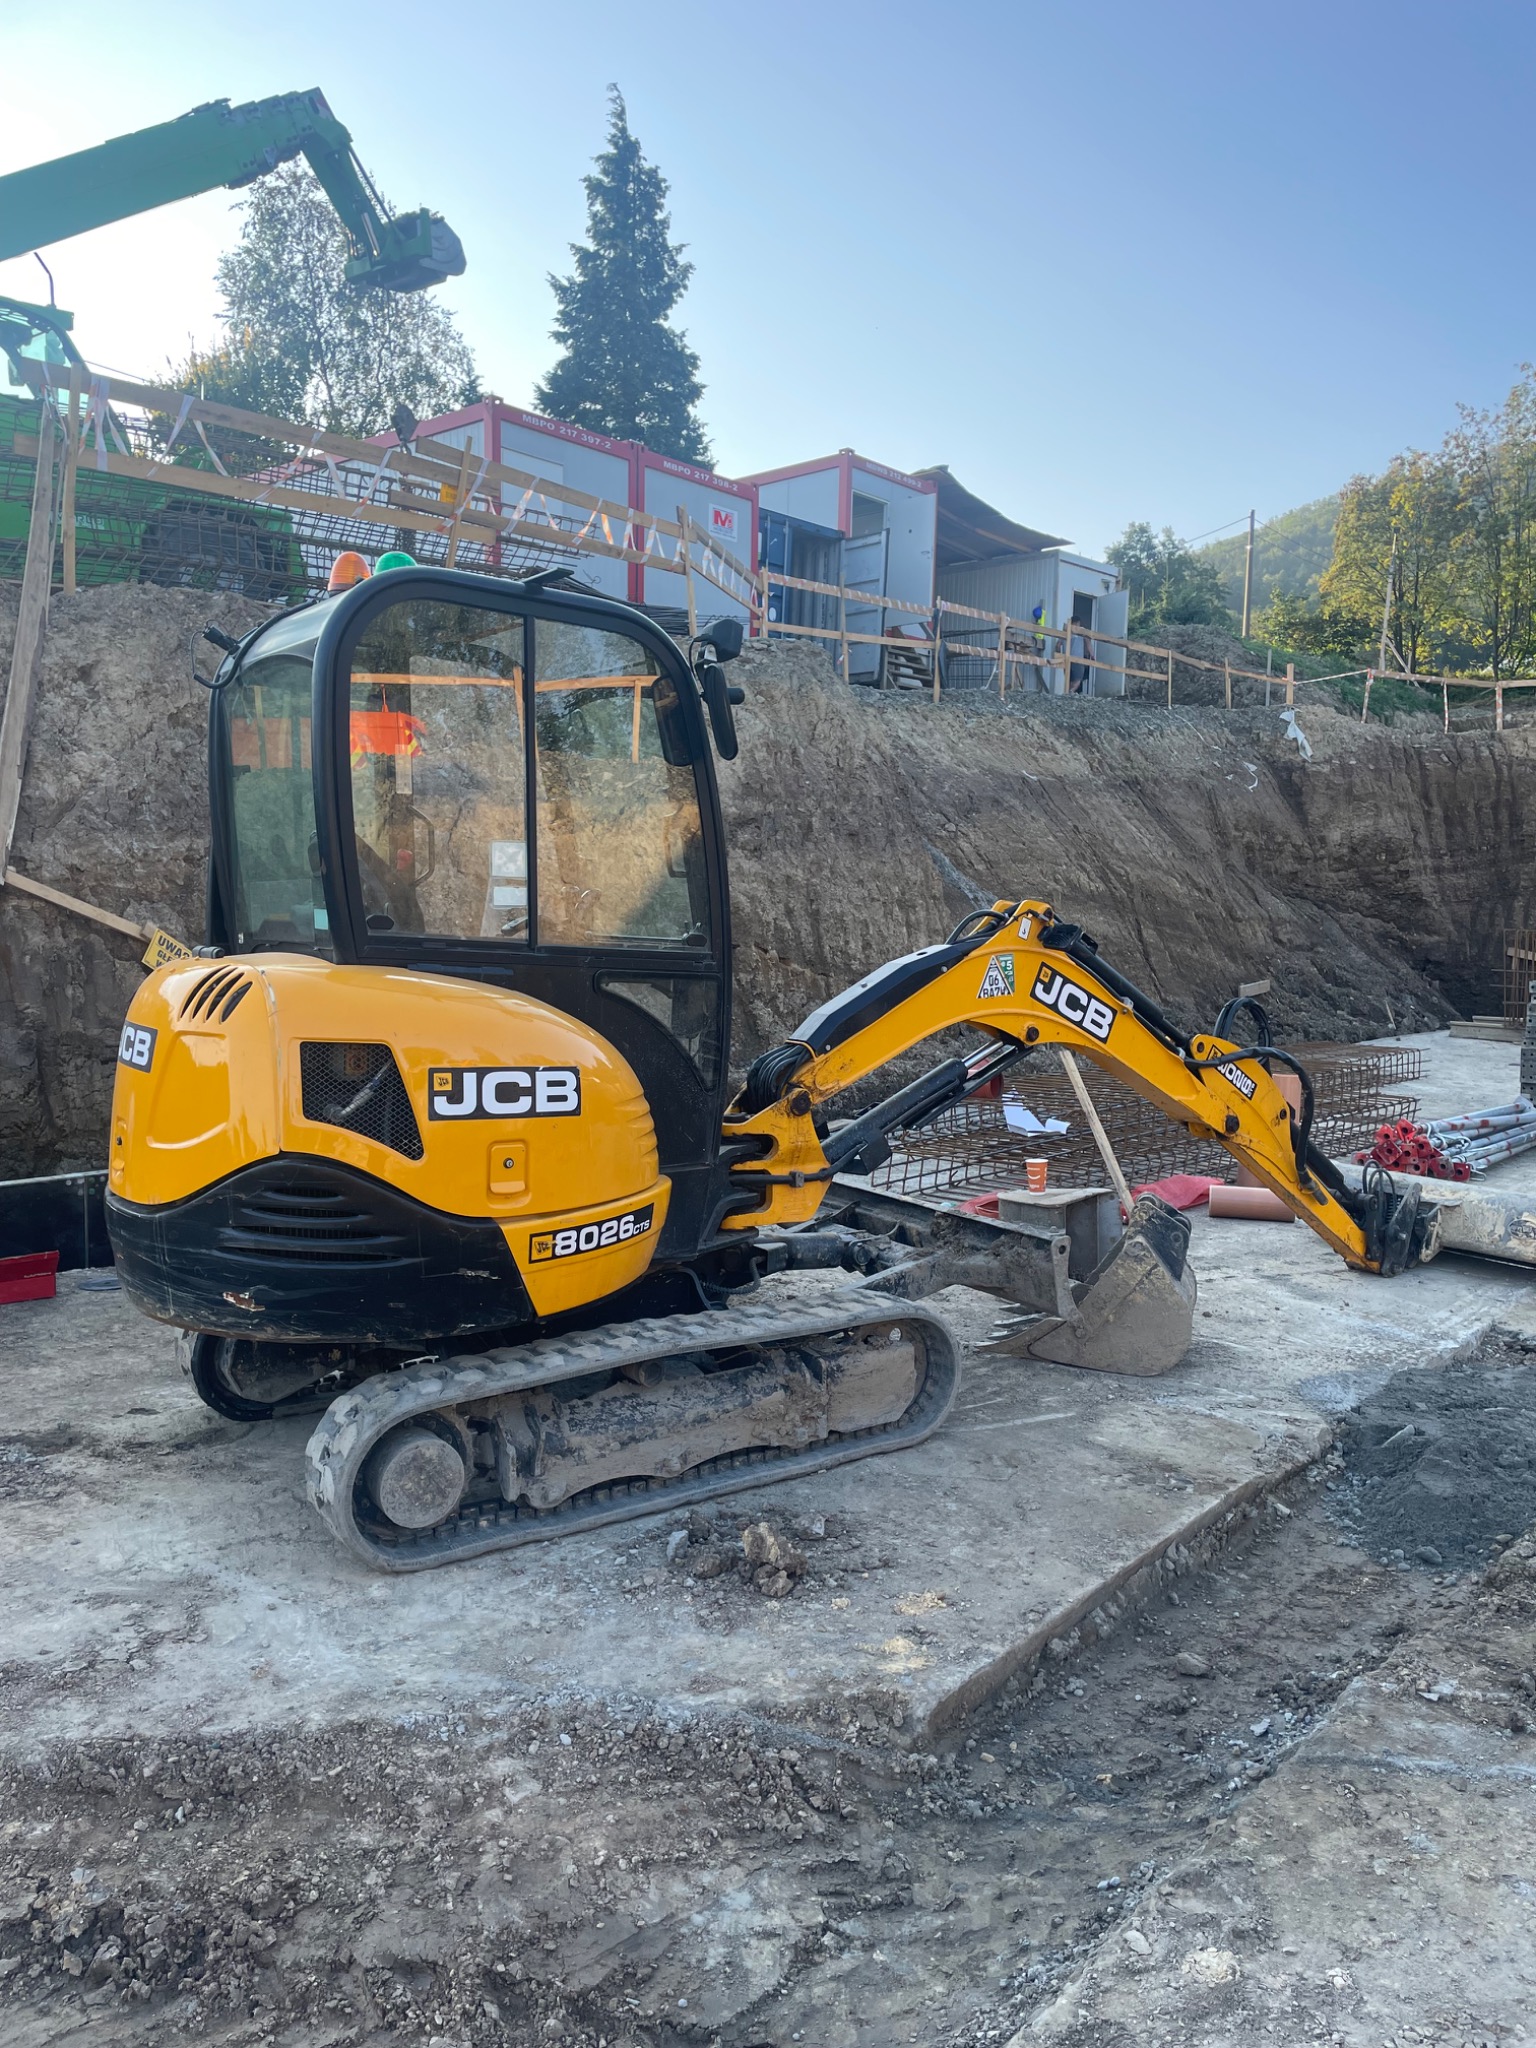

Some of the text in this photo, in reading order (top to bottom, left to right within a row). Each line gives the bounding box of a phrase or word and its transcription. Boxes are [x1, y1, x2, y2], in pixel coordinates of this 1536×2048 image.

[559, 426, 578, 438] 217
[694, 470, 710, 482] 217
[1035, 974, 1114, 1039] JCB
[433, 1070, 579, 1116] JCB
